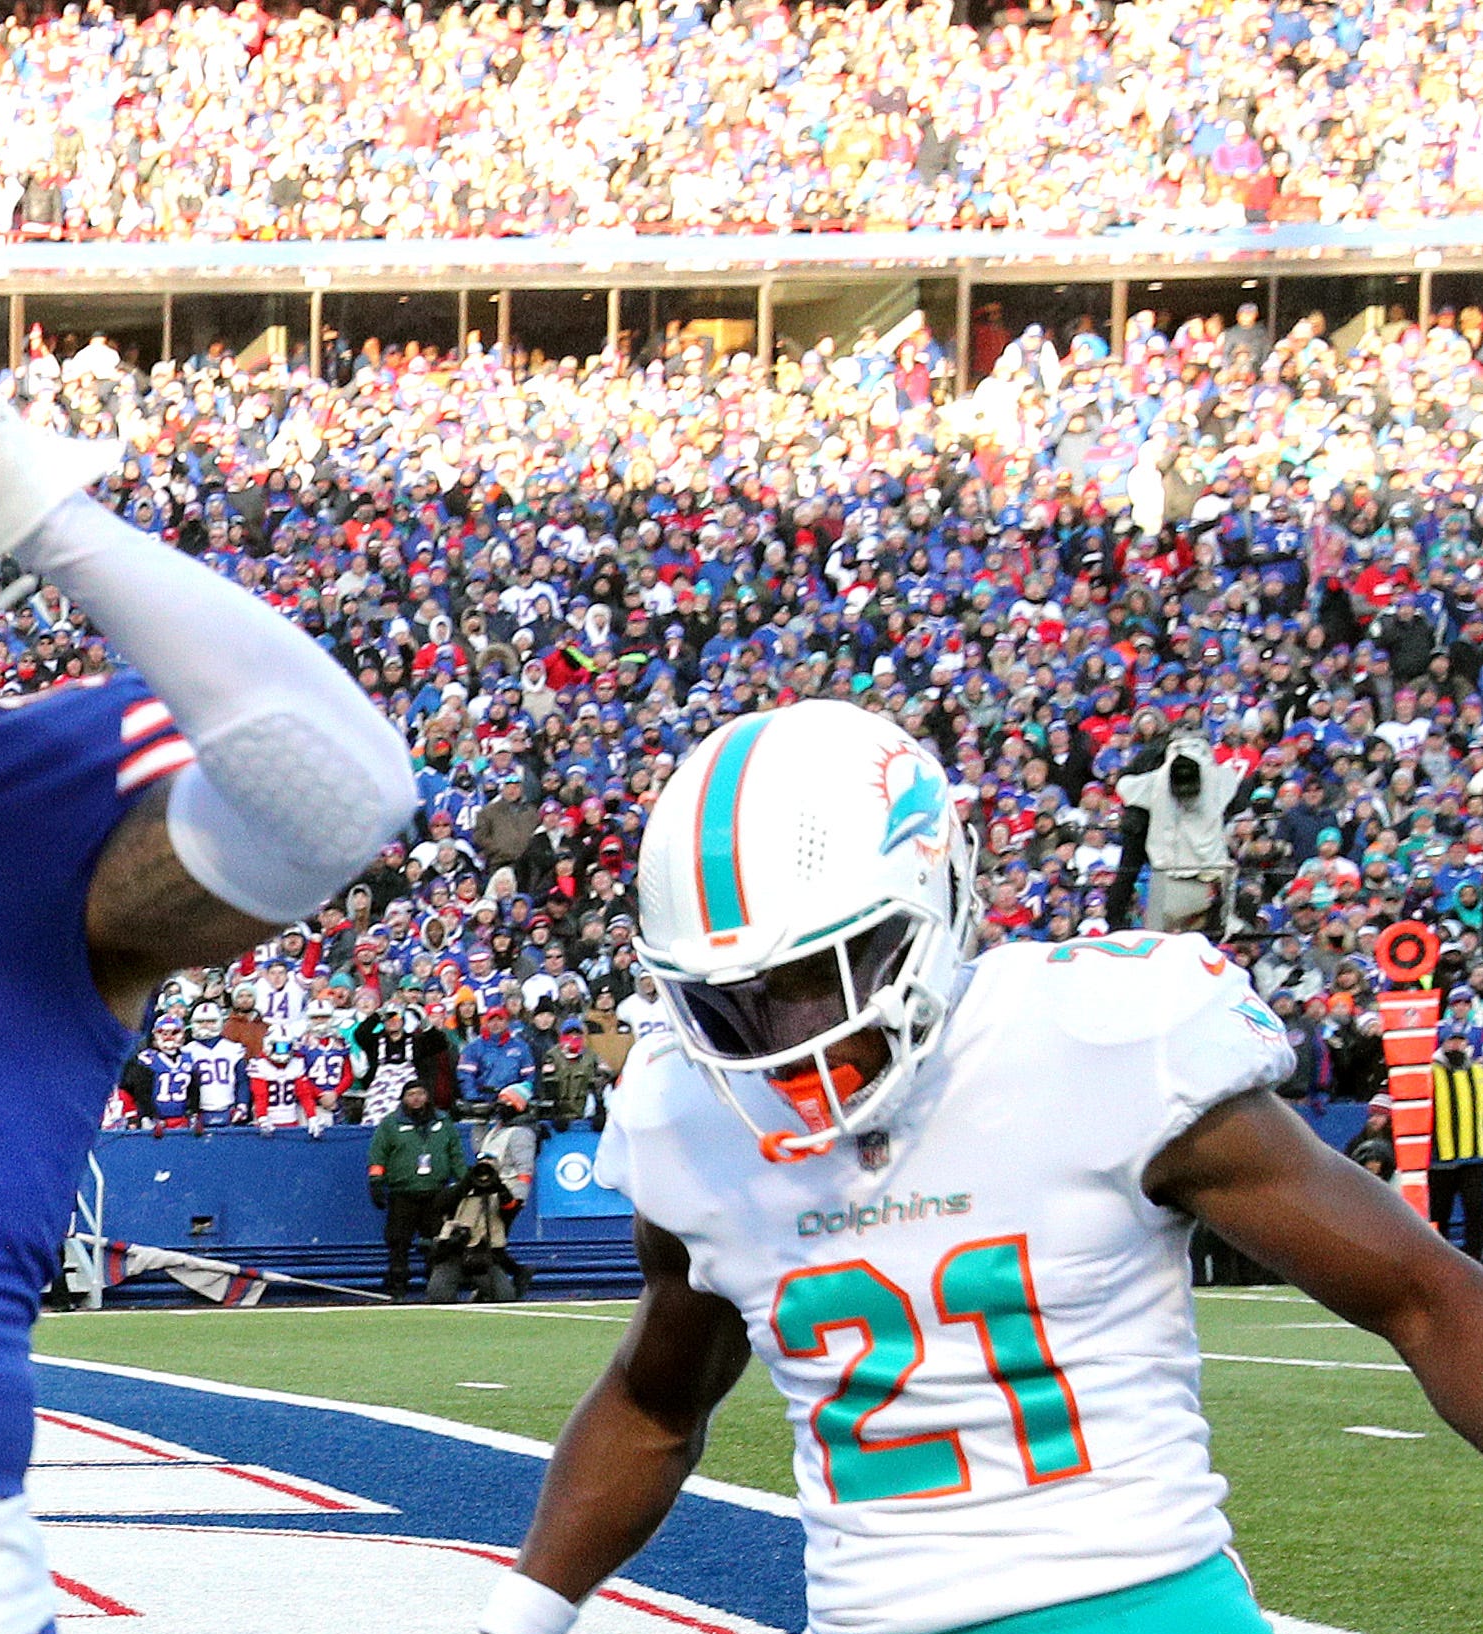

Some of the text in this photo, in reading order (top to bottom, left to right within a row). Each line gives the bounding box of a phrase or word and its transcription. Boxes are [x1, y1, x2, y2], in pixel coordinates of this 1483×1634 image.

[265, 991, 290, 1020] 14
[308, 1053, 345, 1086] 43
[155, 1071, 192, 1102] 13
[797, 1192, 972, 1237] Dolphins
[769, 1234, 1092, 1505] 21
